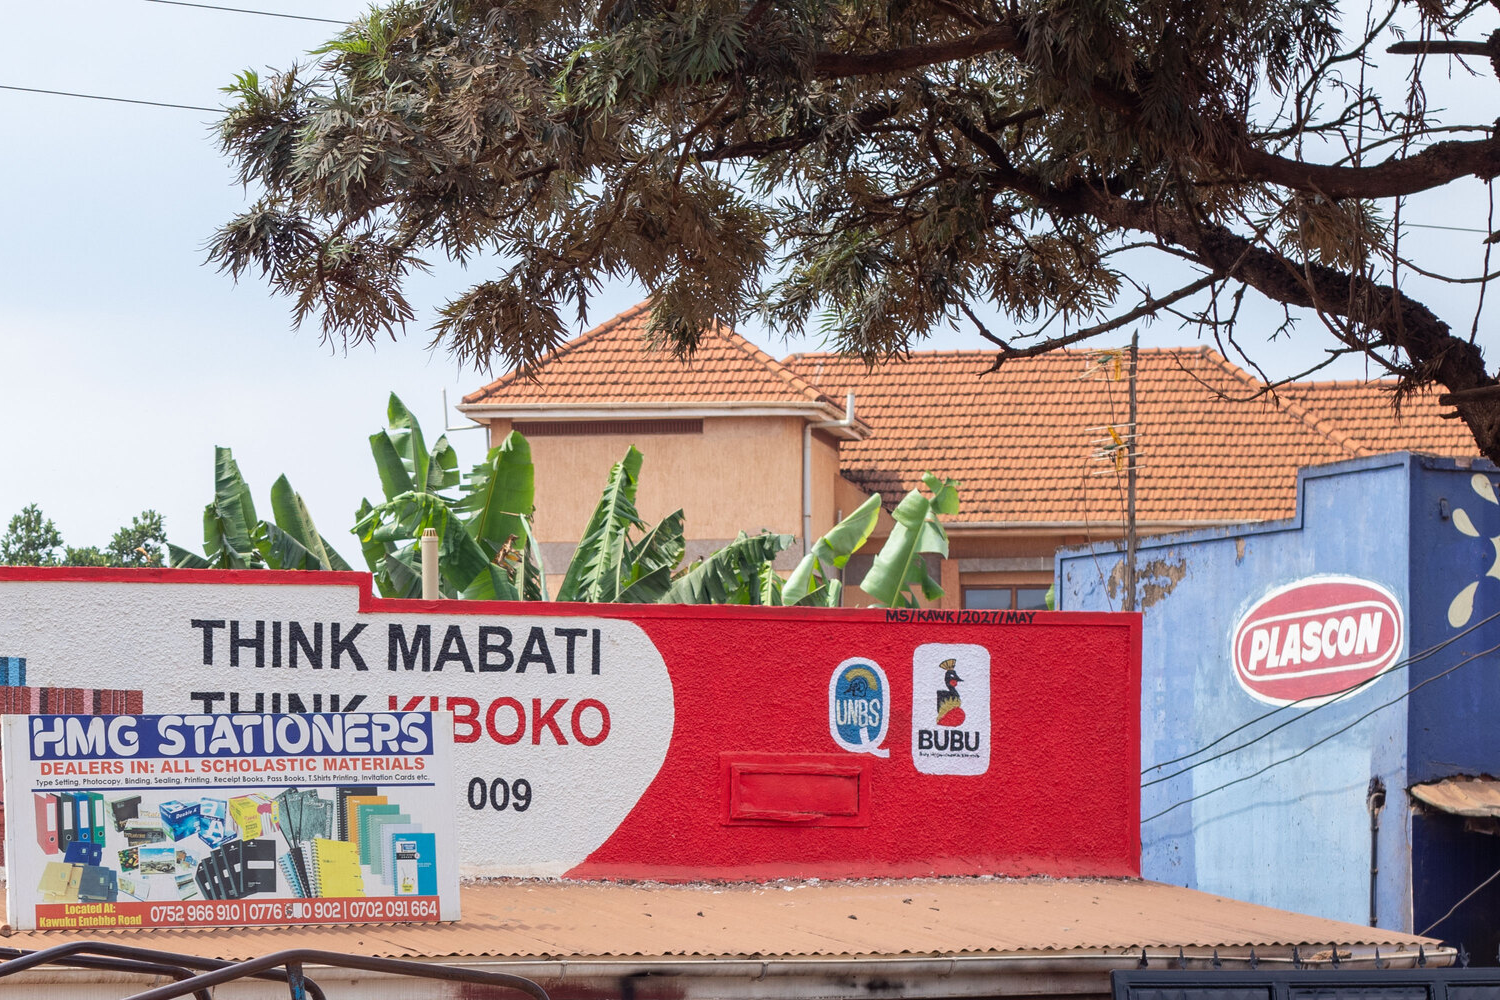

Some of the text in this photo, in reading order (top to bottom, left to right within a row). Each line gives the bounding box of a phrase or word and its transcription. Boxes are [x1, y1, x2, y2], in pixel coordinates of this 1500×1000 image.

[191, 619, 601, 675] THINK MABATI
[1248, 611, 1382, 671] PLASCON
[836, 699, 880, 727] UNBS
[33, 713, 428, 757] HMG STATIONERS
[918, 729, 980, 751] BUBU
[40, 757, 425, 776] DEALERS IN: ALL SCHOLASTIC MATERIALS
[36, 779, 53, 787] Type
[214, 775, 241, 784] Receipt
[361, 773, 393, 781] Invitation
[394, 773, 415, 781] Cards
[467, 777, 532, 812] 009
[65, 903, 116, 914] Located At:
[150, 905, 185, 922] 0752
[187, 904, 214, 921] 966
[217, 904, 240, 921] 910
[250, 903, 282, 920] 0776
[314, 902, 341, 918] 902
[350, 901, 383, 918] 0702
[386, 901, 409, 917] 091
[411, 900, 437, 917] 664
[39, 914, 142, 928] Kawuku Entebbe Road
